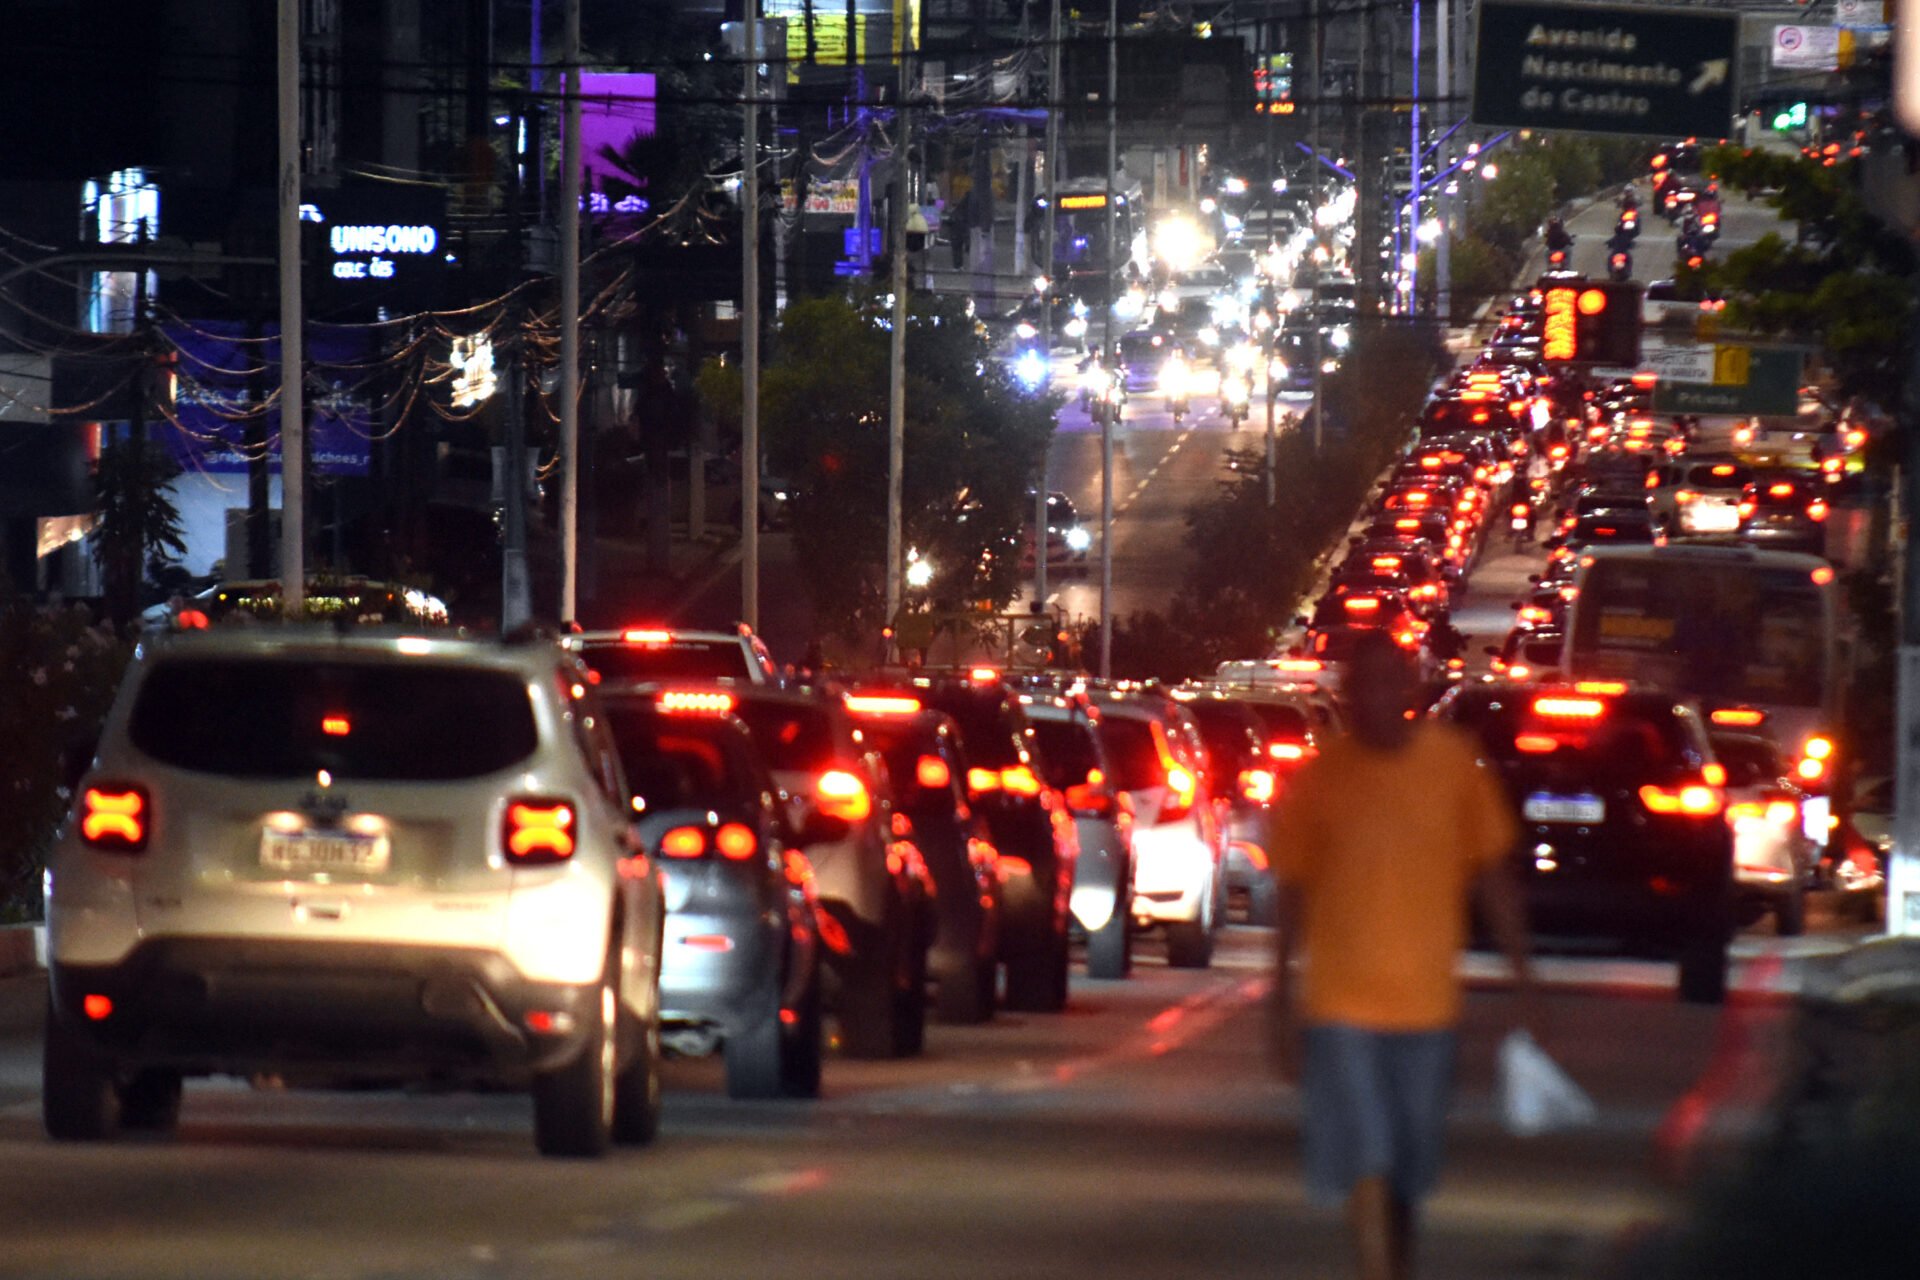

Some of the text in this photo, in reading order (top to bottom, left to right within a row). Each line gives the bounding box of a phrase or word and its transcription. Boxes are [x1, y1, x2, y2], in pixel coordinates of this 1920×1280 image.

[1526, 24, 1638, 50] Avenida
[1521, 55, 1682, 85] Nascimento
[1520, 86, 1651, 115] de Castro
